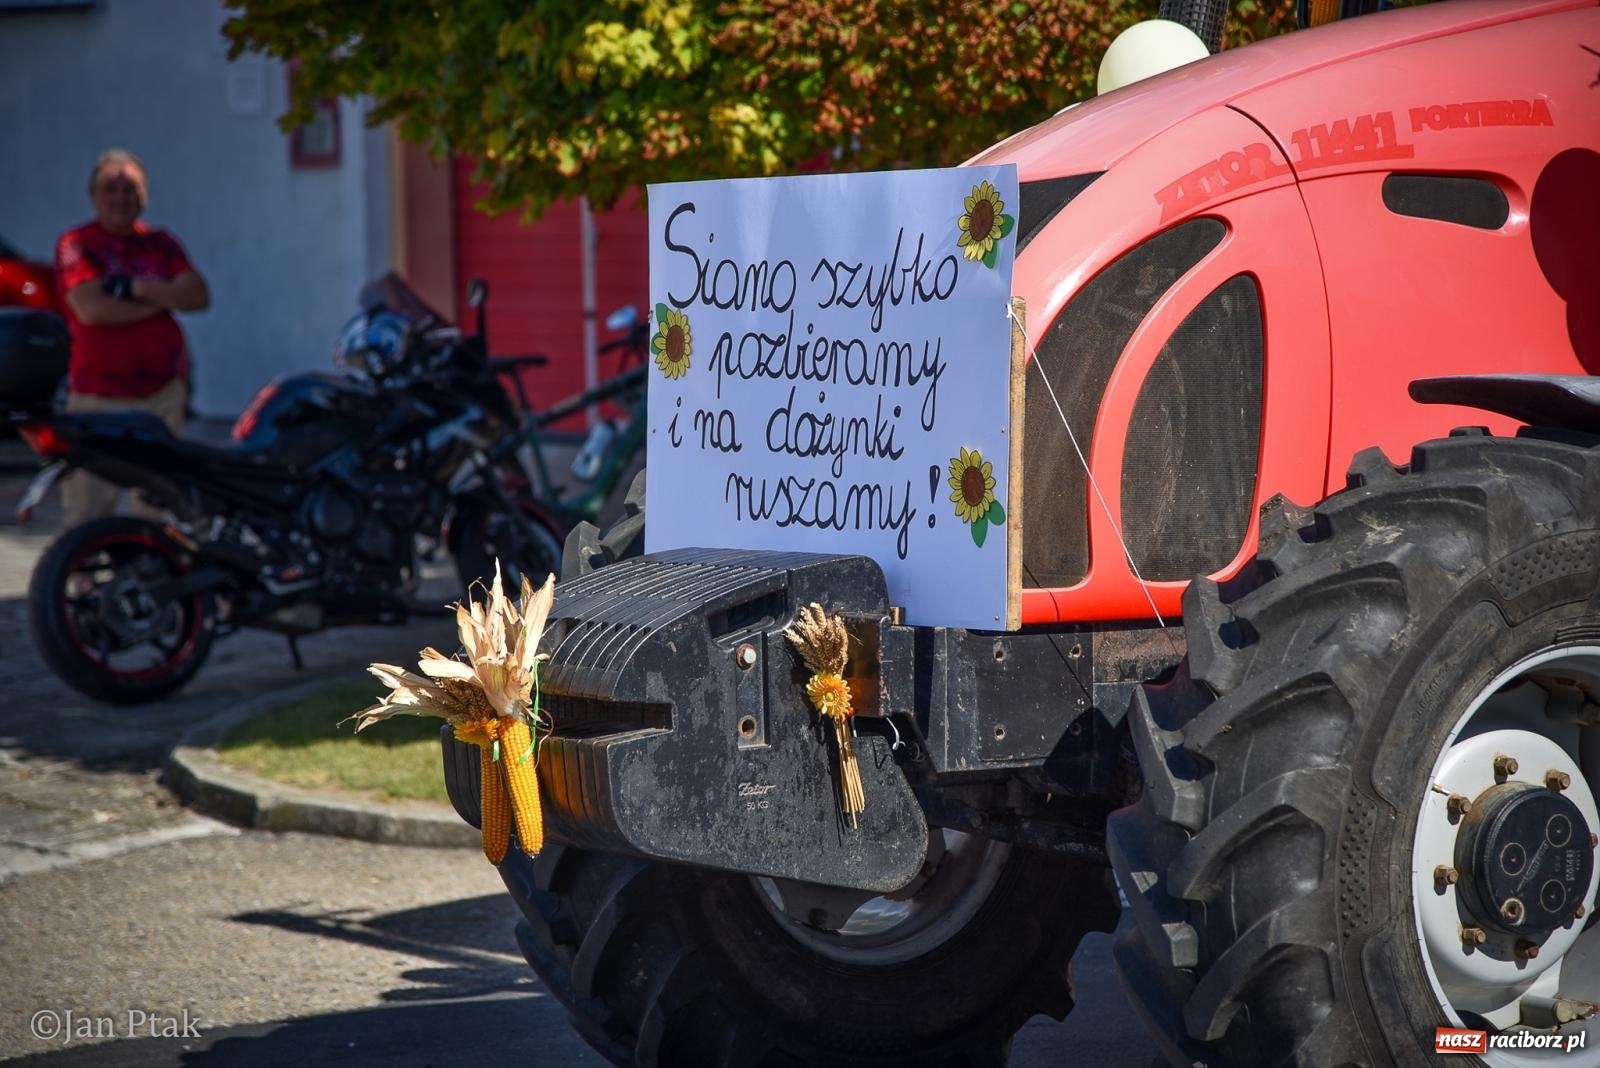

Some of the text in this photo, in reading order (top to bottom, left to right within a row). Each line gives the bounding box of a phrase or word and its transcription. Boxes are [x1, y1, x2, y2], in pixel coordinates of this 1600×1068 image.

[1408, 98, 1554, 132] FORTERRA
[1154, 111, 1414, 226] ZETOR 11441
[665, 202, 959, 332] Siano szybko
[709, 310, 947, 432] pozbieramy
[668, 386, 905, 479] i na dożynki
[738, 782, 776, 796] Zetor
[757, 801, 769, 809] KG
